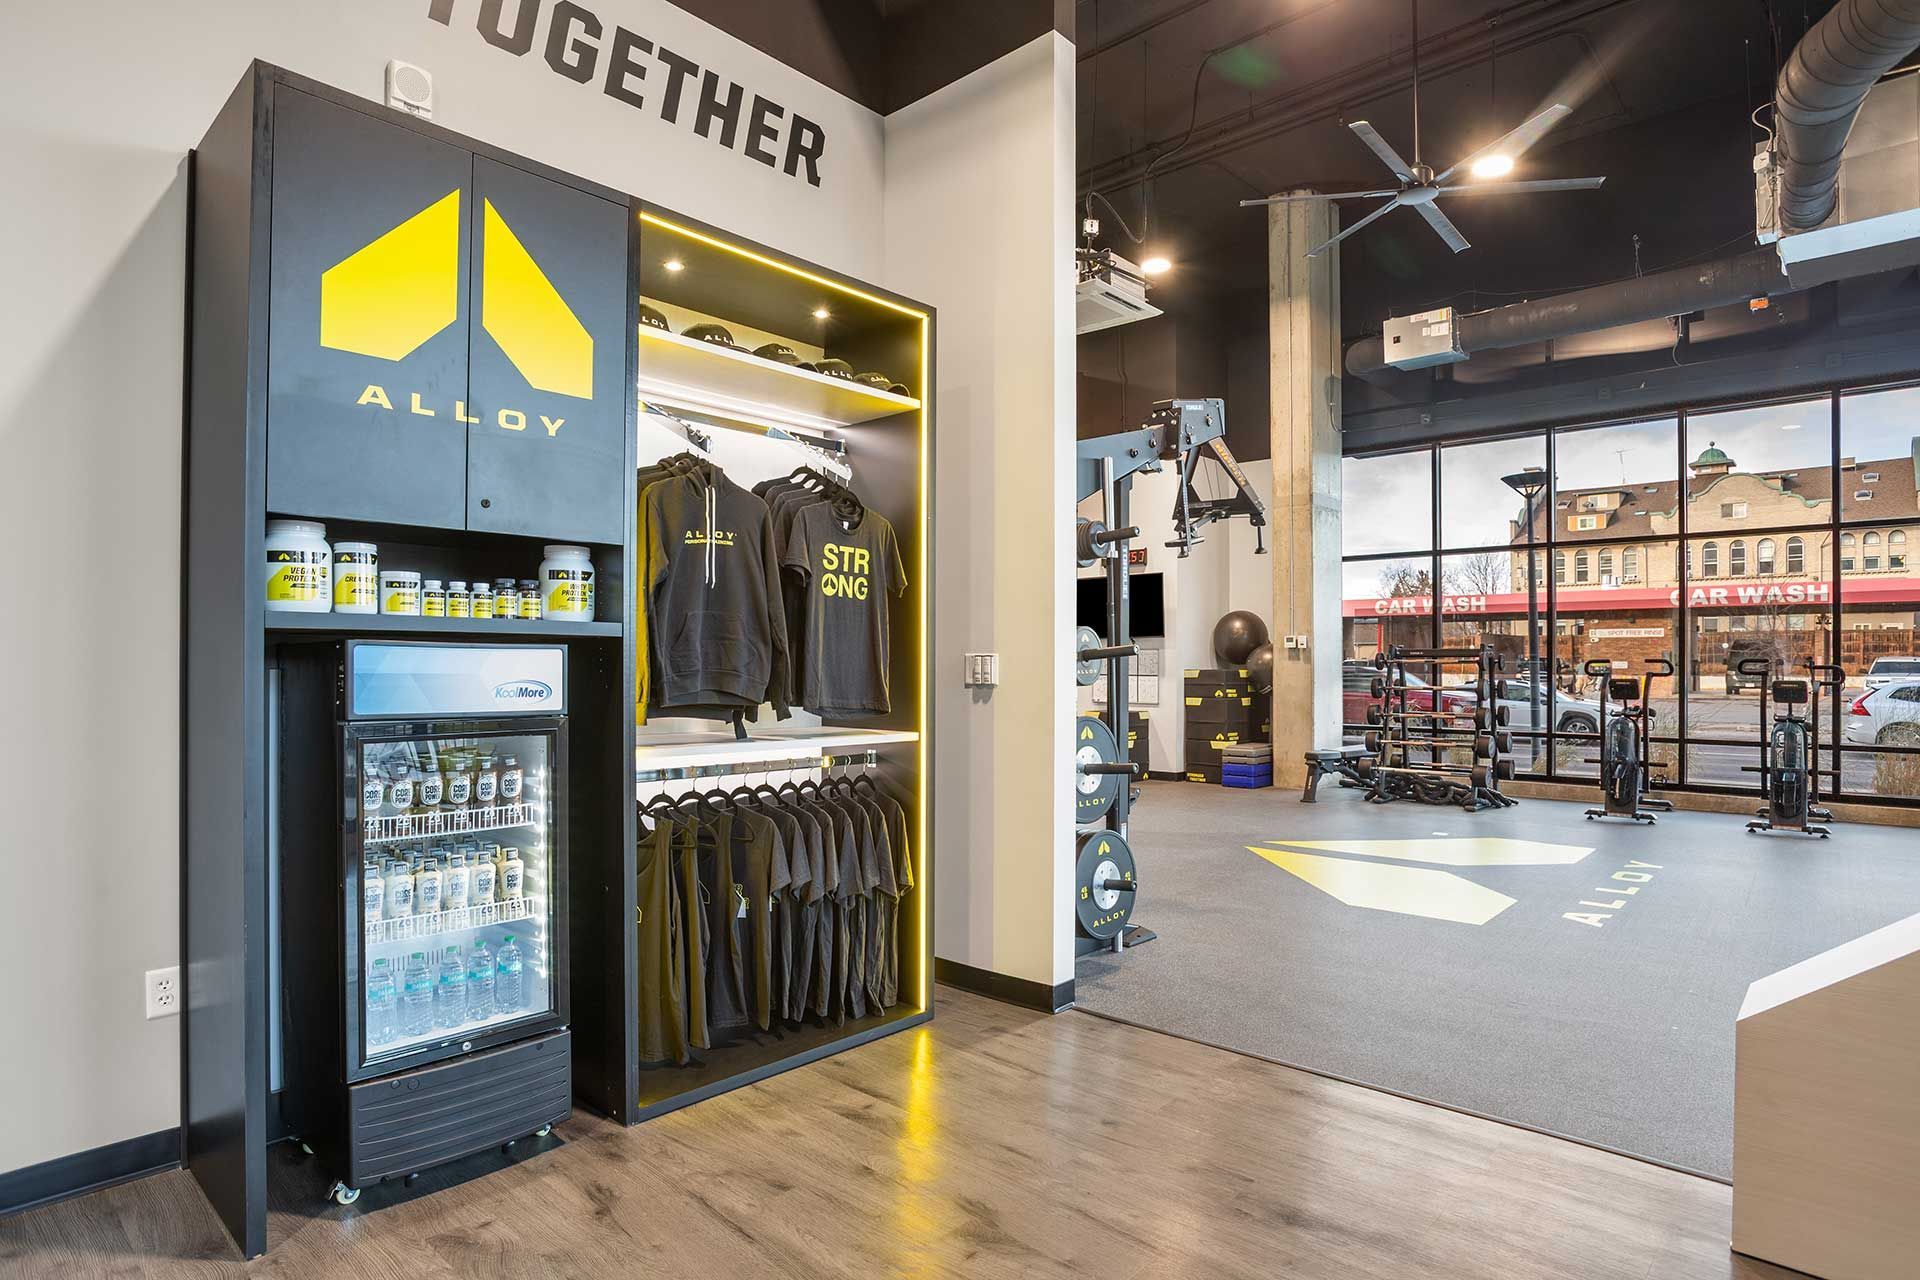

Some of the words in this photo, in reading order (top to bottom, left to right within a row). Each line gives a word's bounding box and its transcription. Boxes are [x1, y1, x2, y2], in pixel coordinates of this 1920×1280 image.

[641, 315, 665, 329] LOY
[703, 334, 735, 346] ALL
[356, 384, 566, 437] ALLOY
[685, 530, 735, 540] ALOY
[822, 542, 870, 575] STR
[1670, 587, 1729, 607] CAR
[1737, 583, 1829, 605] WASH
[1375, 598, 1417, 615] CAR
[1423, 595, 1486, 614] WASH
[495, 686, 545, 698] KoolMore
[1078, 797, 1106, 808] LLOY
[1561, 859, 1665, 928] ALLOY
[1093, 909, 1125, 928] ALLOY
